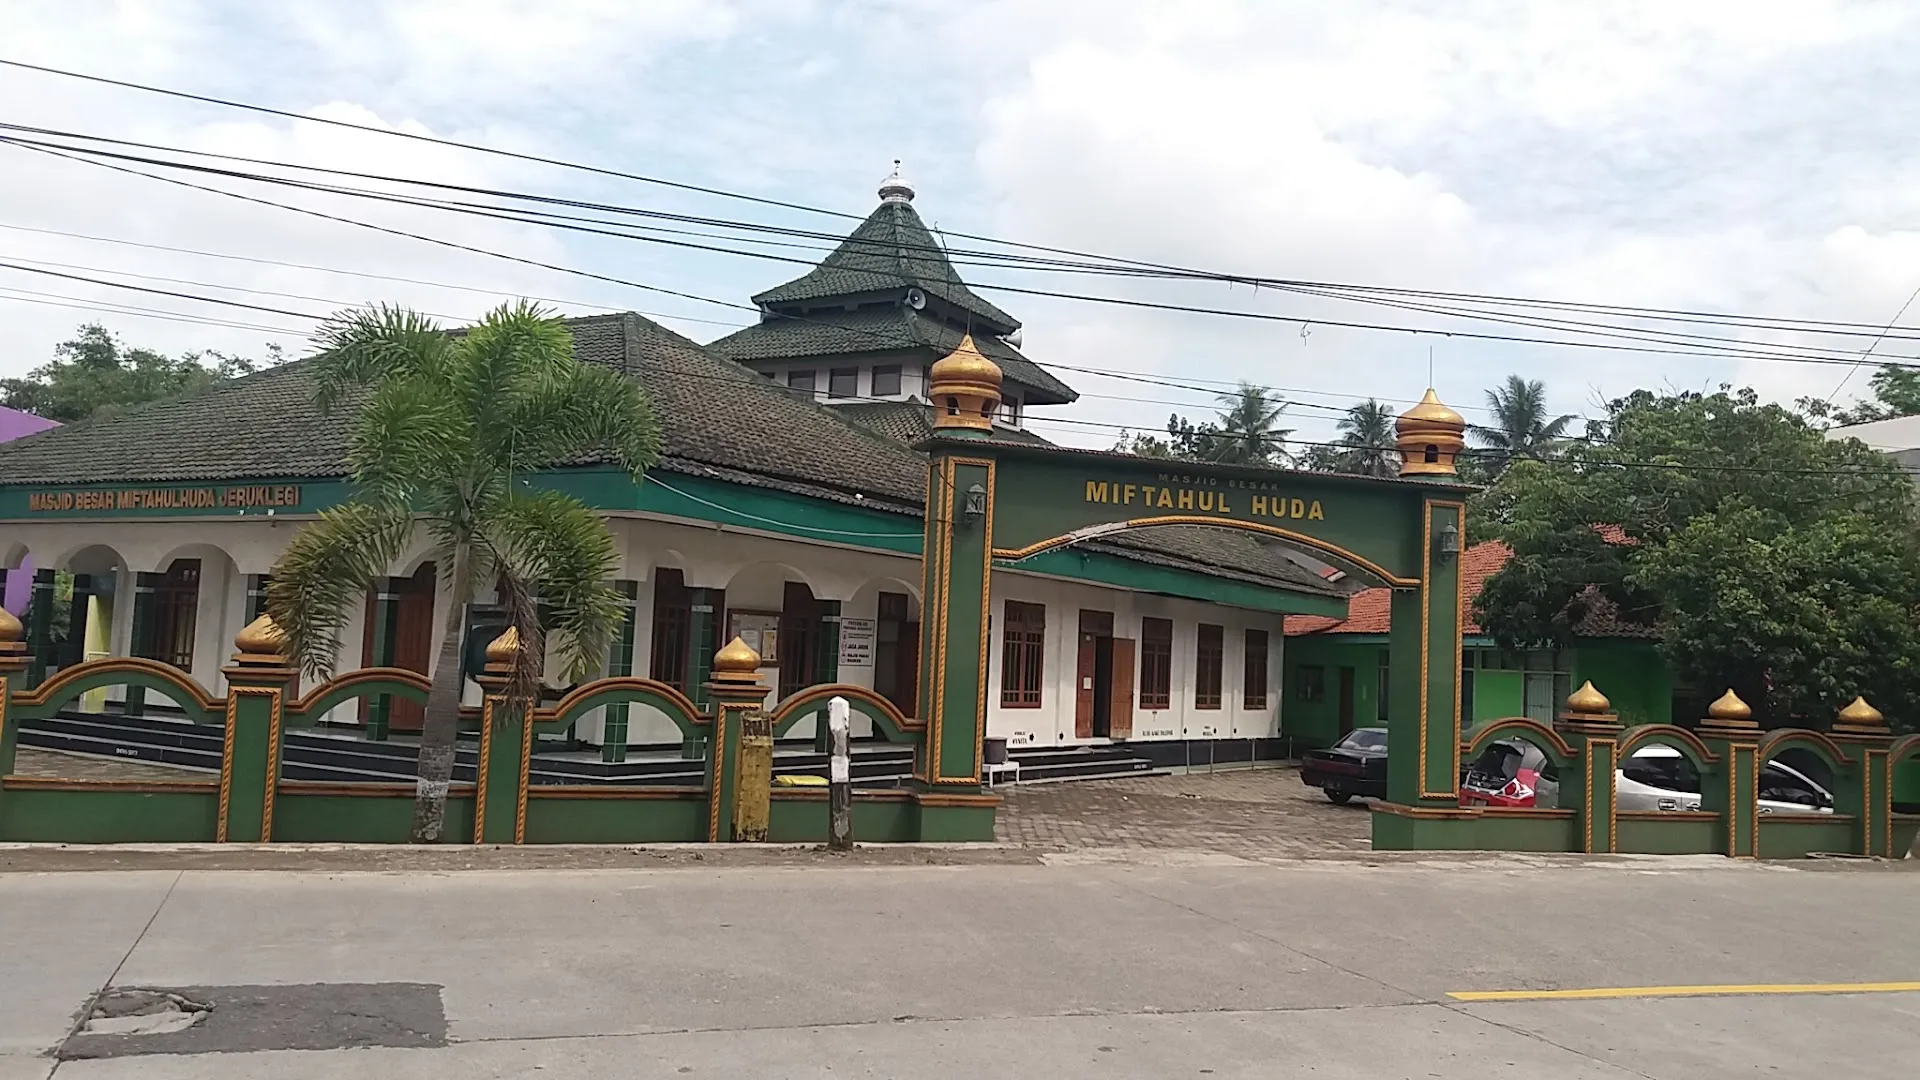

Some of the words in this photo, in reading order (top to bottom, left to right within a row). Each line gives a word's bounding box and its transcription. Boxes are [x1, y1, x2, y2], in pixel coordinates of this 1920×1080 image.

[1158, 473, 1217, 486] MASJID
[1228, 479, 1280, 491] BESAR
[29, 493, 73, 511] MASJID
[75, 491, 115, 510] BESAR
[219, 485, 300, 507] JERUKLEGI
[1085, 481, 1231, 513] MIFTAHUL
[1251, 495, 1325, 521] HUDA
